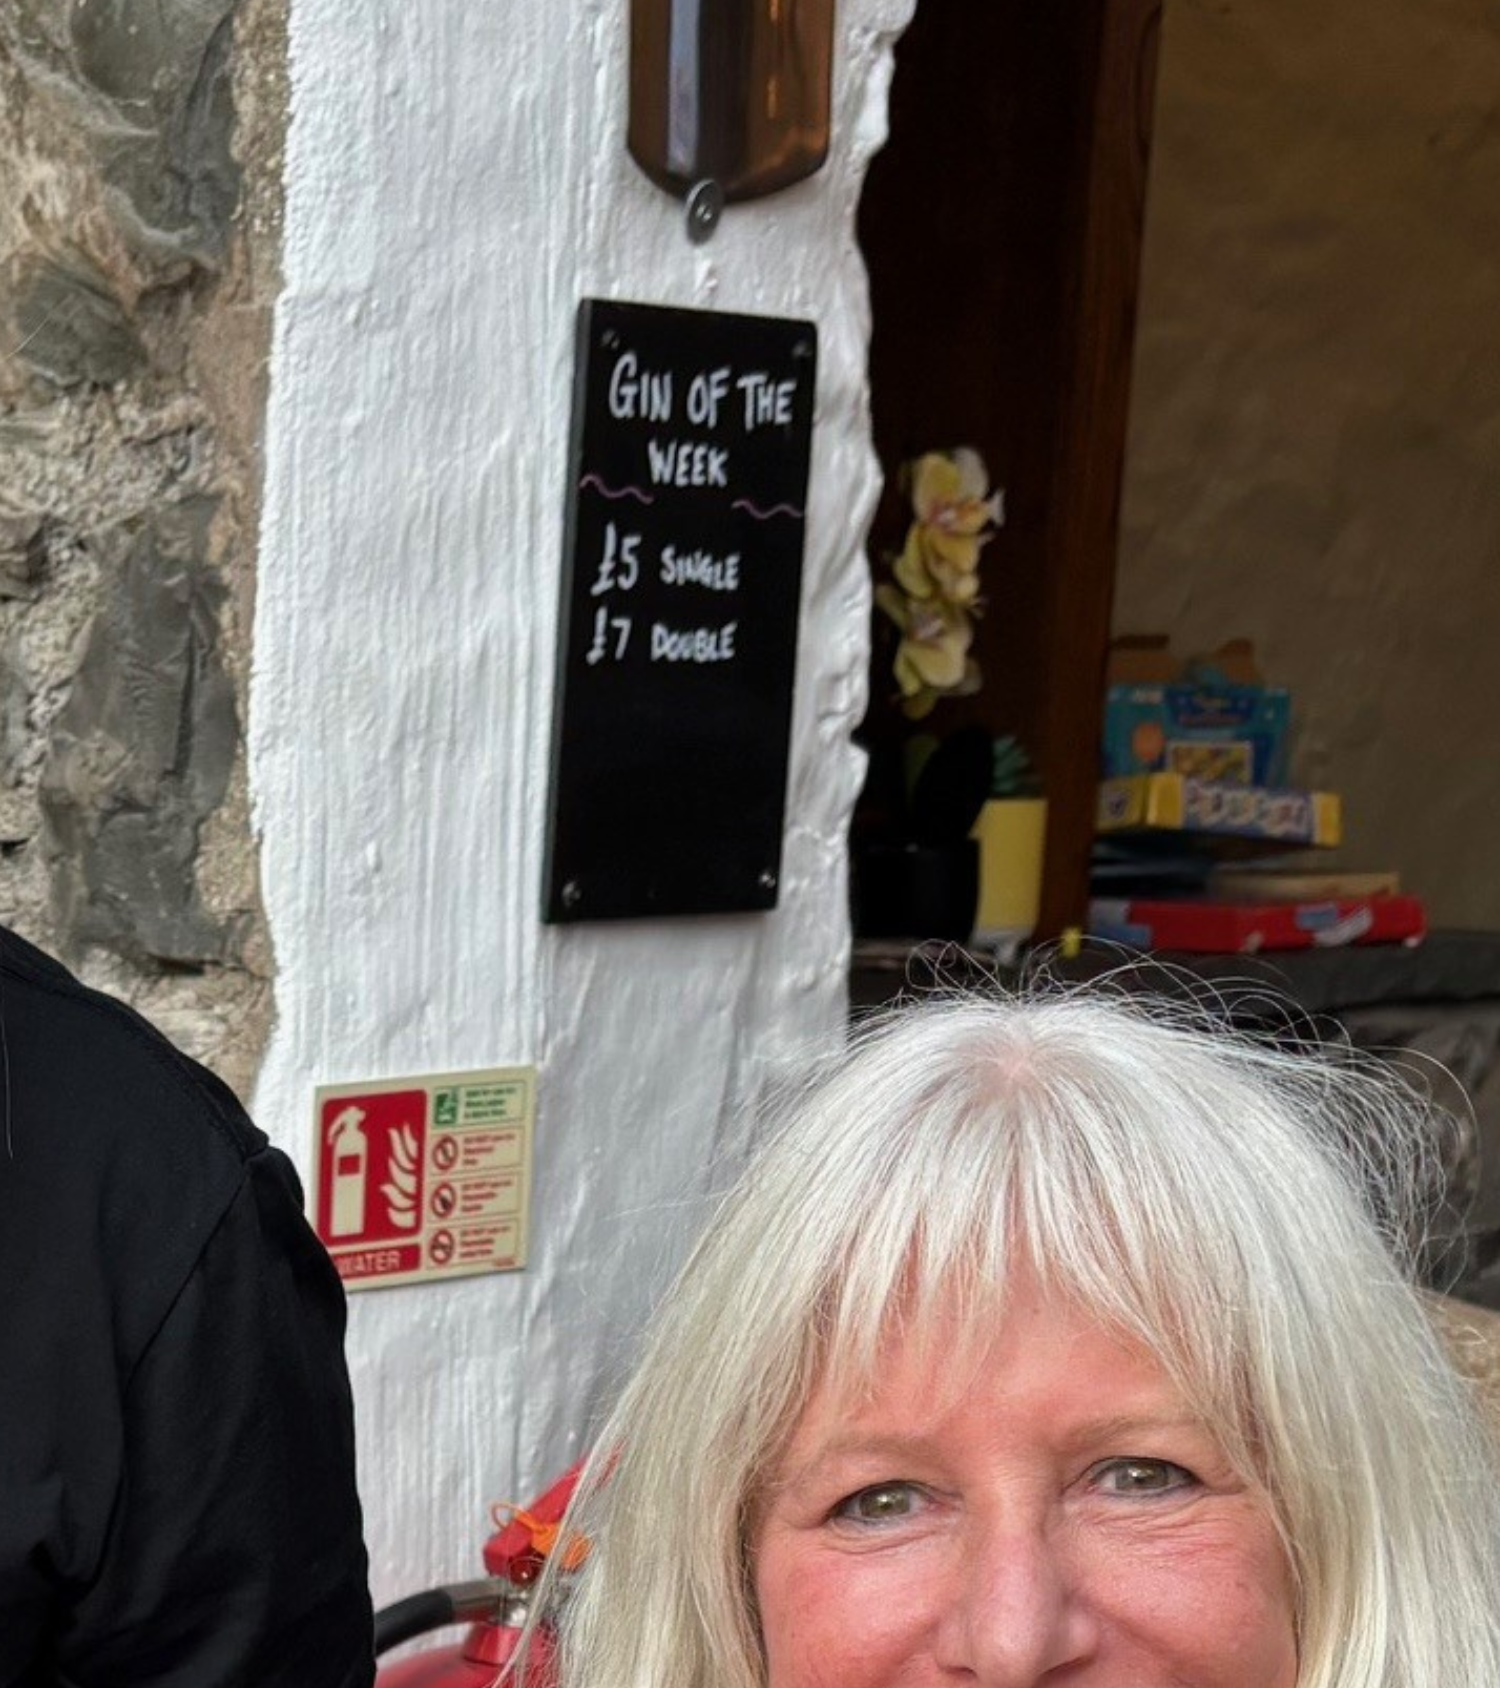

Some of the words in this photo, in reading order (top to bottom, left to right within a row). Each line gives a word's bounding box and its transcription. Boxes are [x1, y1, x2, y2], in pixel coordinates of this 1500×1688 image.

[608, 351, 673, 423] GIN
[686, 365, 732, 429] OF
[736, 371, 798, 432] THE
[648, 438, 729, 488] WEEK
[589, 522, 642, 597] £5
[586, 606, 632, 666] £7
[650, 621, 738, 664] DOUBLE
